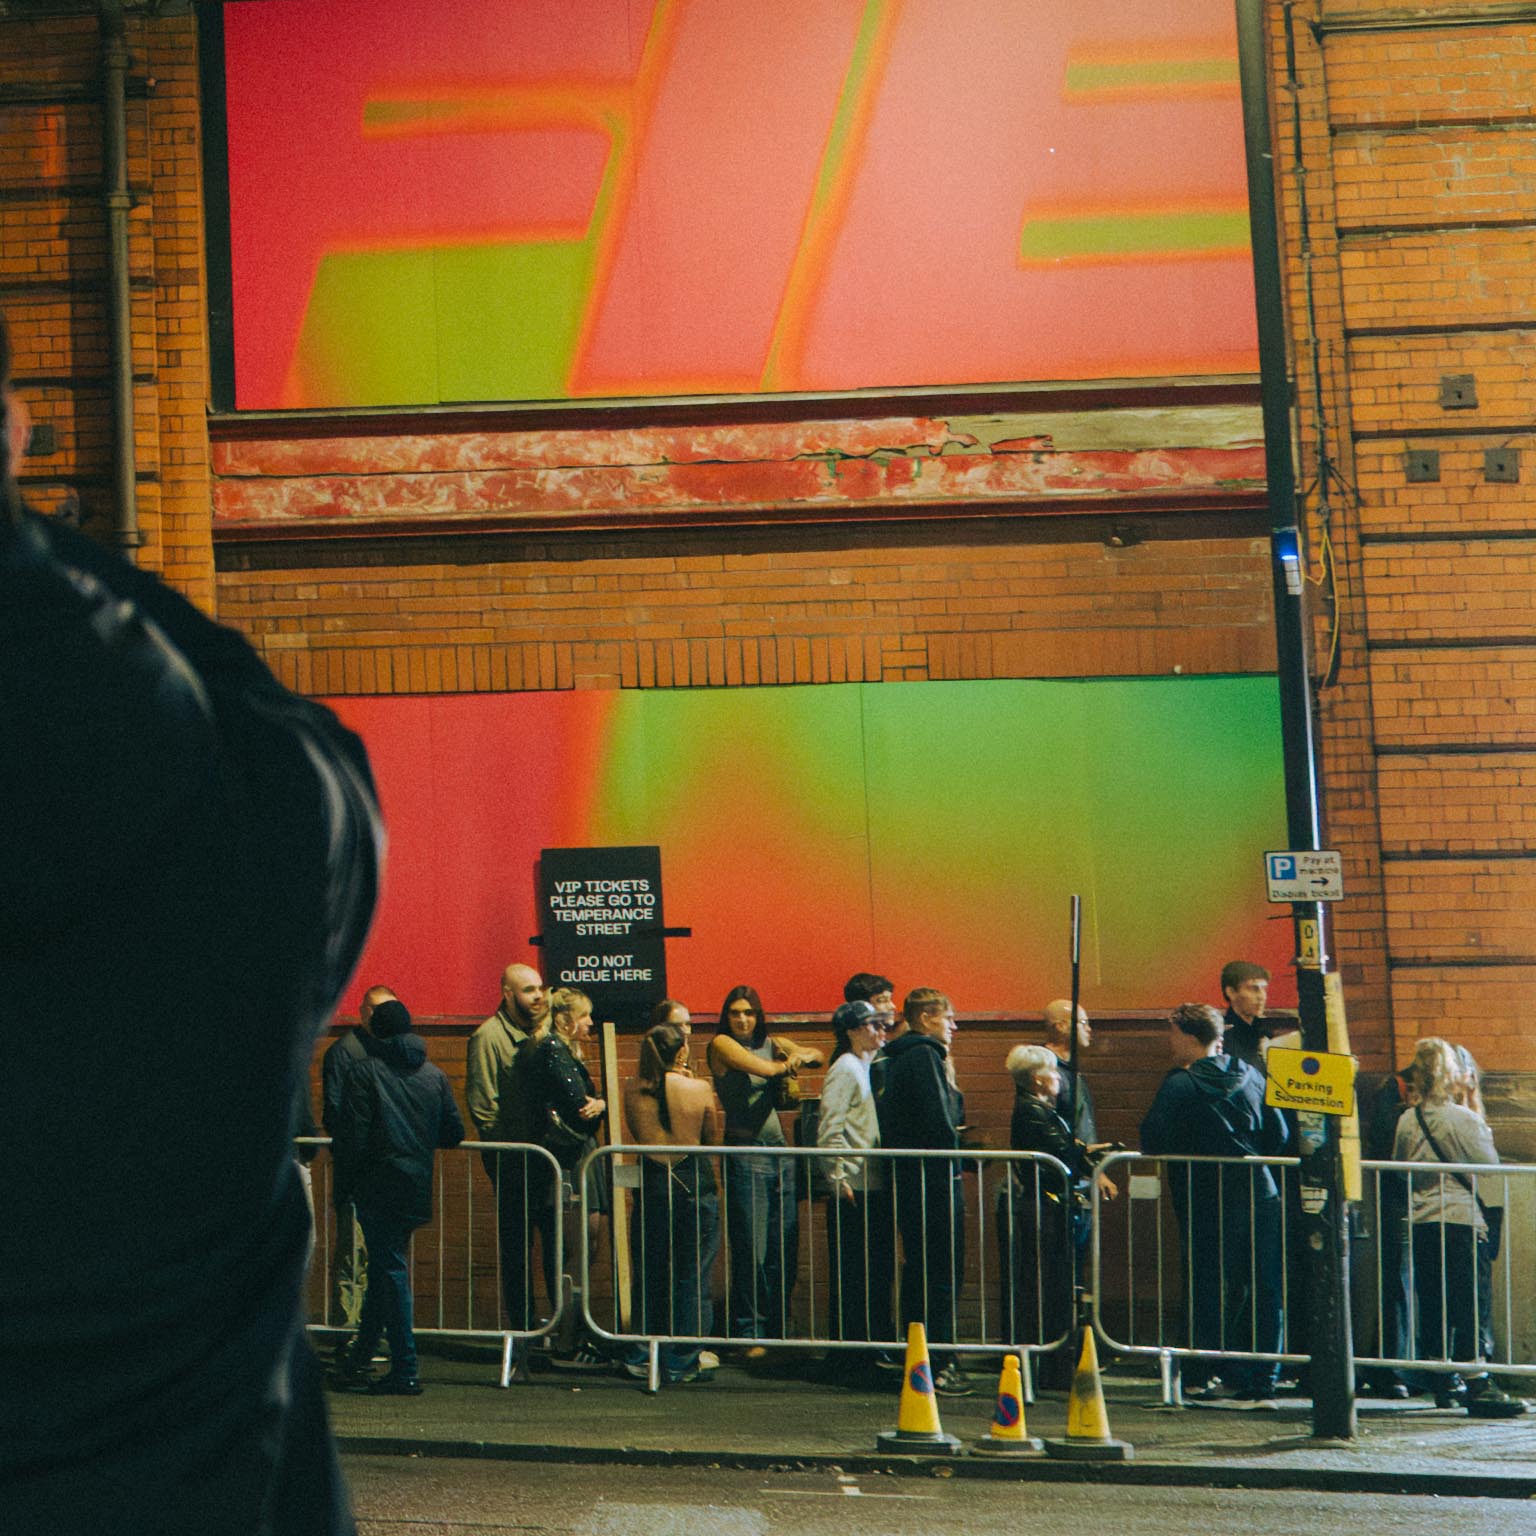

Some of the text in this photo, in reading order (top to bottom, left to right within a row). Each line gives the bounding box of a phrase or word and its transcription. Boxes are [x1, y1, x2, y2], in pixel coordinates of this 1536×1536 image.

[554, 879, 650, 893] VIP TICKETS
[550, 893, 656, 908] PLEASE GO TO
[553, 908, 654, 922] TEMPERANCE
[576, 922, 632, 936] STREET
[577, 954, 634, 968] DO NOT
[560, 968, 653, 982] QUEUE HERE
[1287, 1077, 1333, 1095] Parking
[1274, 1090, 1344, 1108] Suspension
